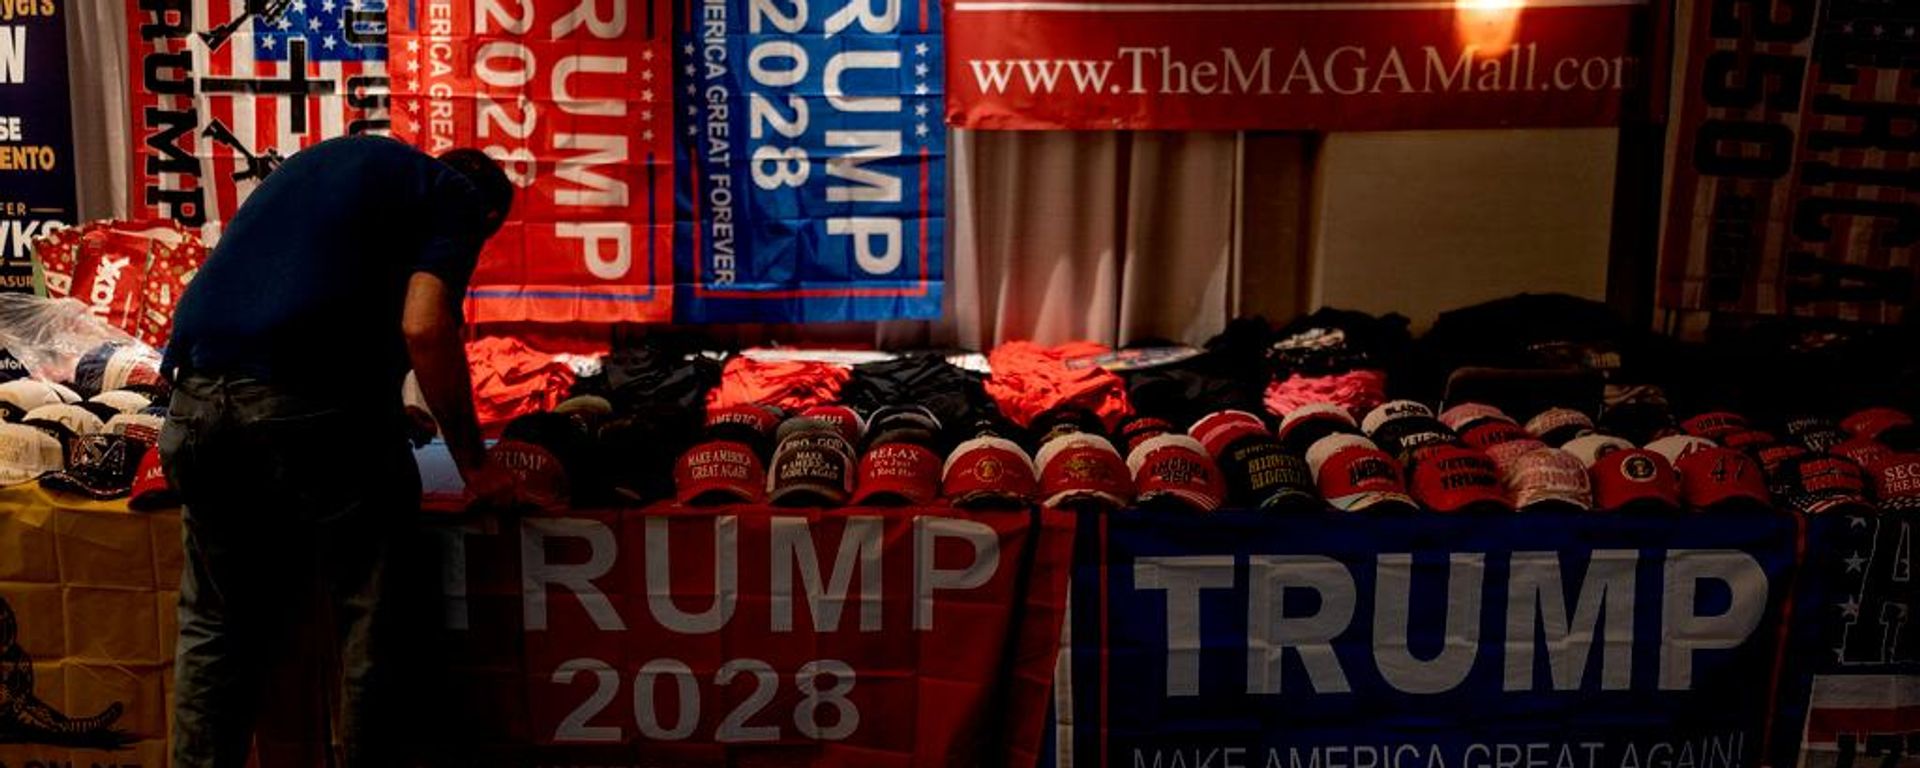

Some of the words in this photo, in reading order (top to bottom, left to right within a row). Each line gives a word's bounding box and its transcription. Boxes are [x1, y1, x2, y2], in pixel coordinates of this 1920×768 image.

[0, 0, 56, 20] yers
[706, 84, 732, 164] GREAT
[748, 0, 812, 191] 2028
[709, 170, 737, 286] FOREVER
[687, 451, 713, 469] MAKE
[690, 463, 719, 480] GREAT
[869, 447, 919, 461] RELAX
[1712, 455, 1747, 482] 47
[421, 514, 1001, 635] TRUMP
[1132, 547, 1770, 697] TRUMP
[549, 656, 861, 744] 2028
